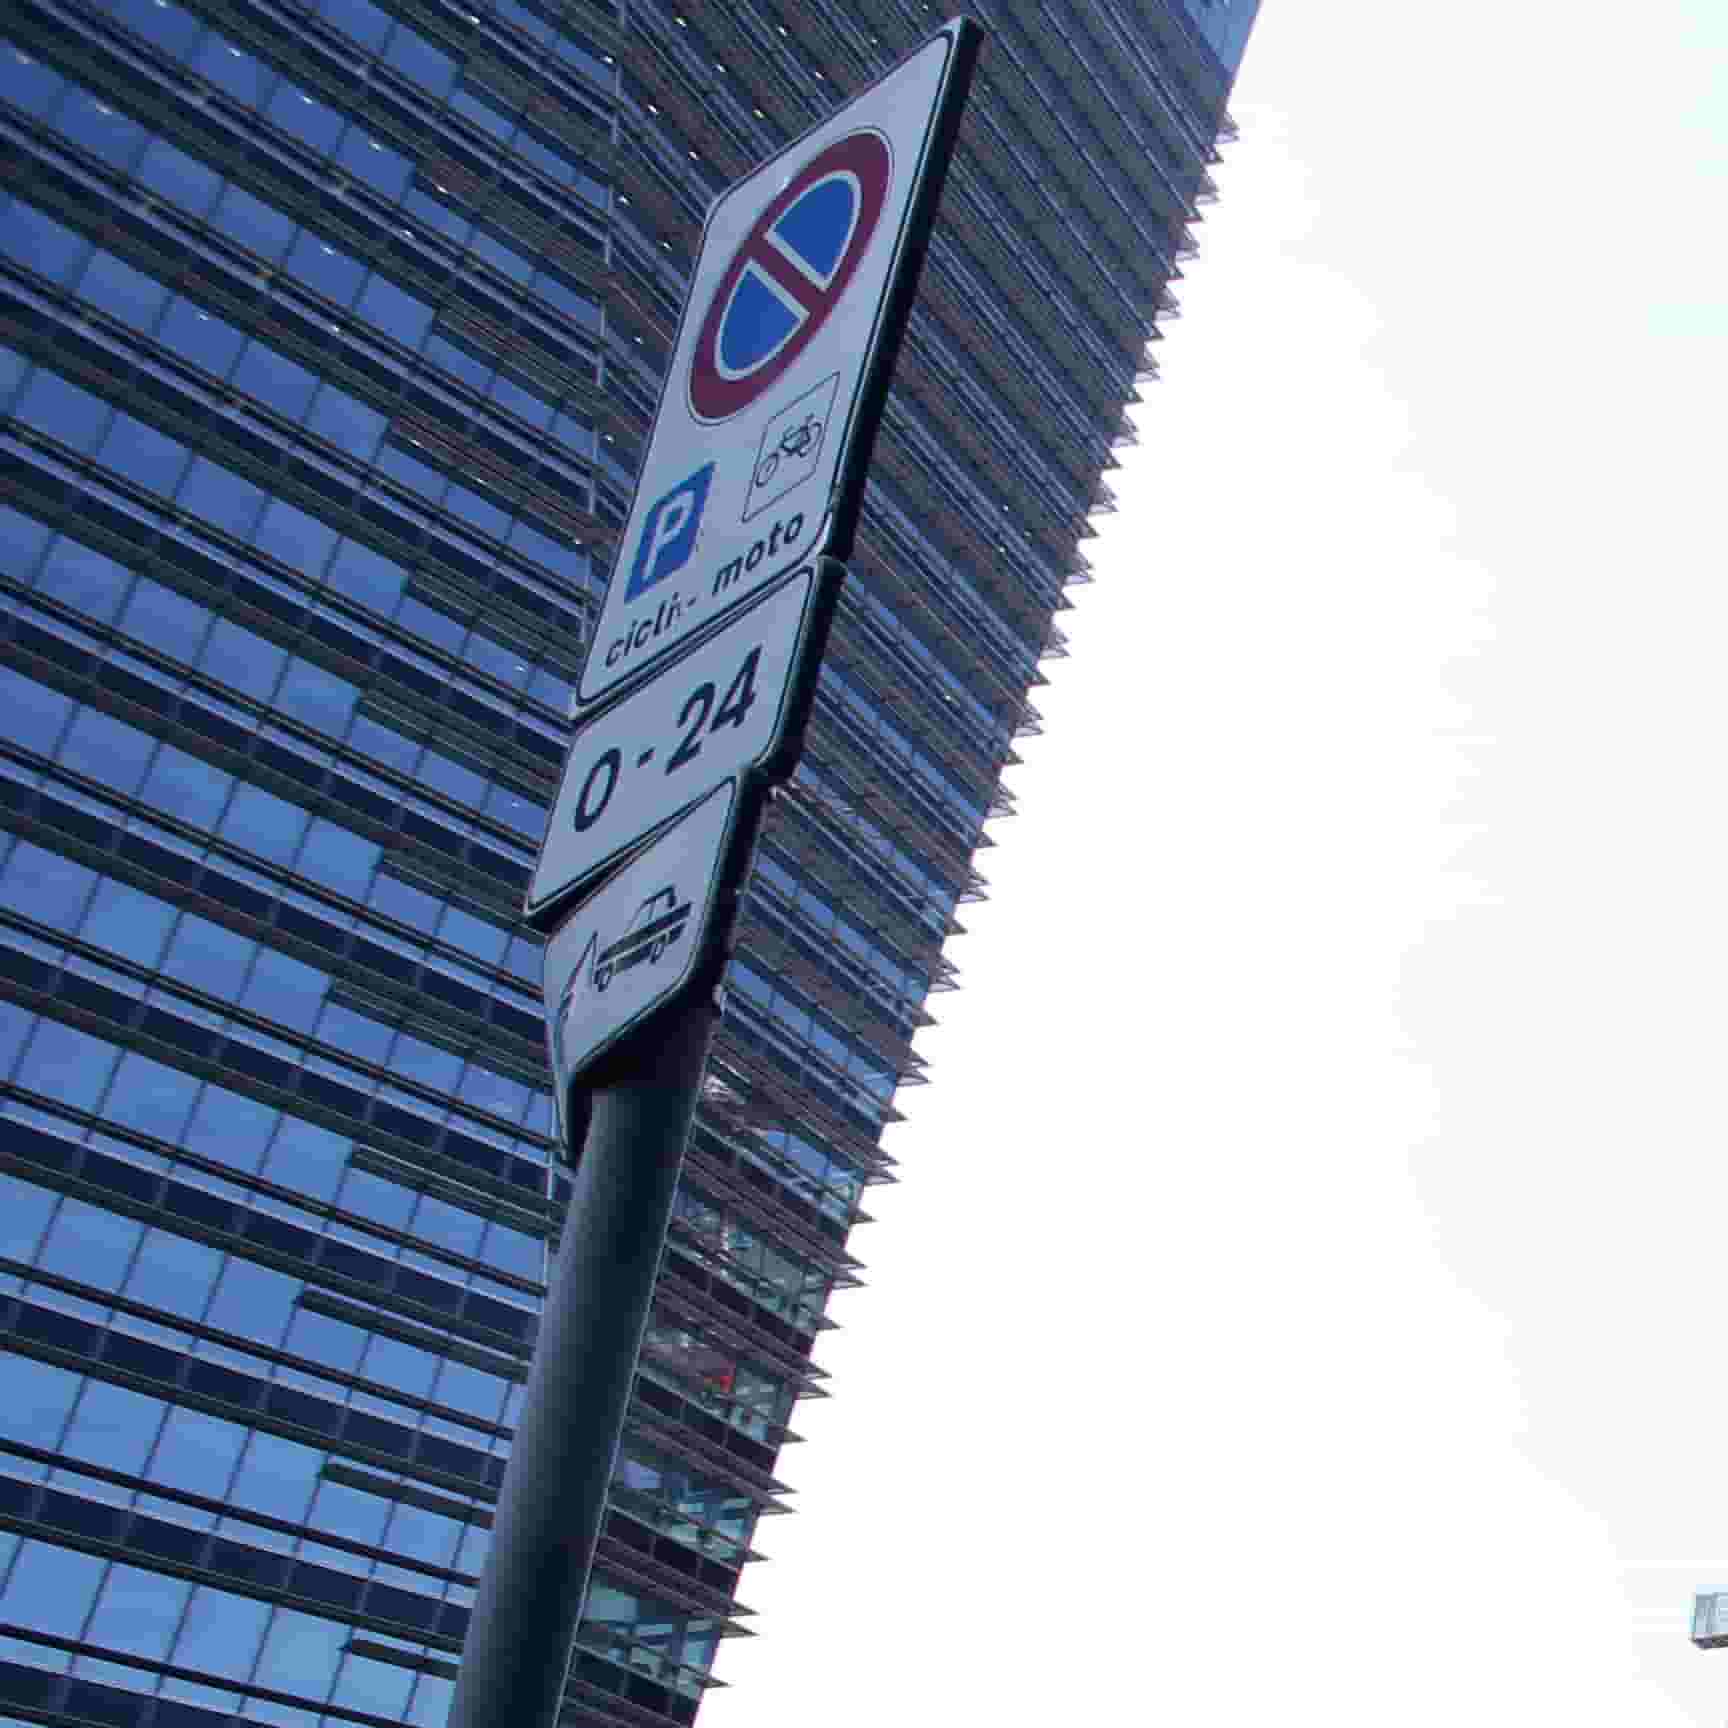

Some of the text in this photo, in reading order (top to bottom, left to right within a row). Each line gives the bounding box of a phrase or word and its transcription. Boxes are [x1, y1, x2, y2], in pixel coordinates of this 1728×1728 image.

[711, 513, 804, 598] moto
[574, 748, 622, 833] 0
[664, 644, 763, 776] 24
